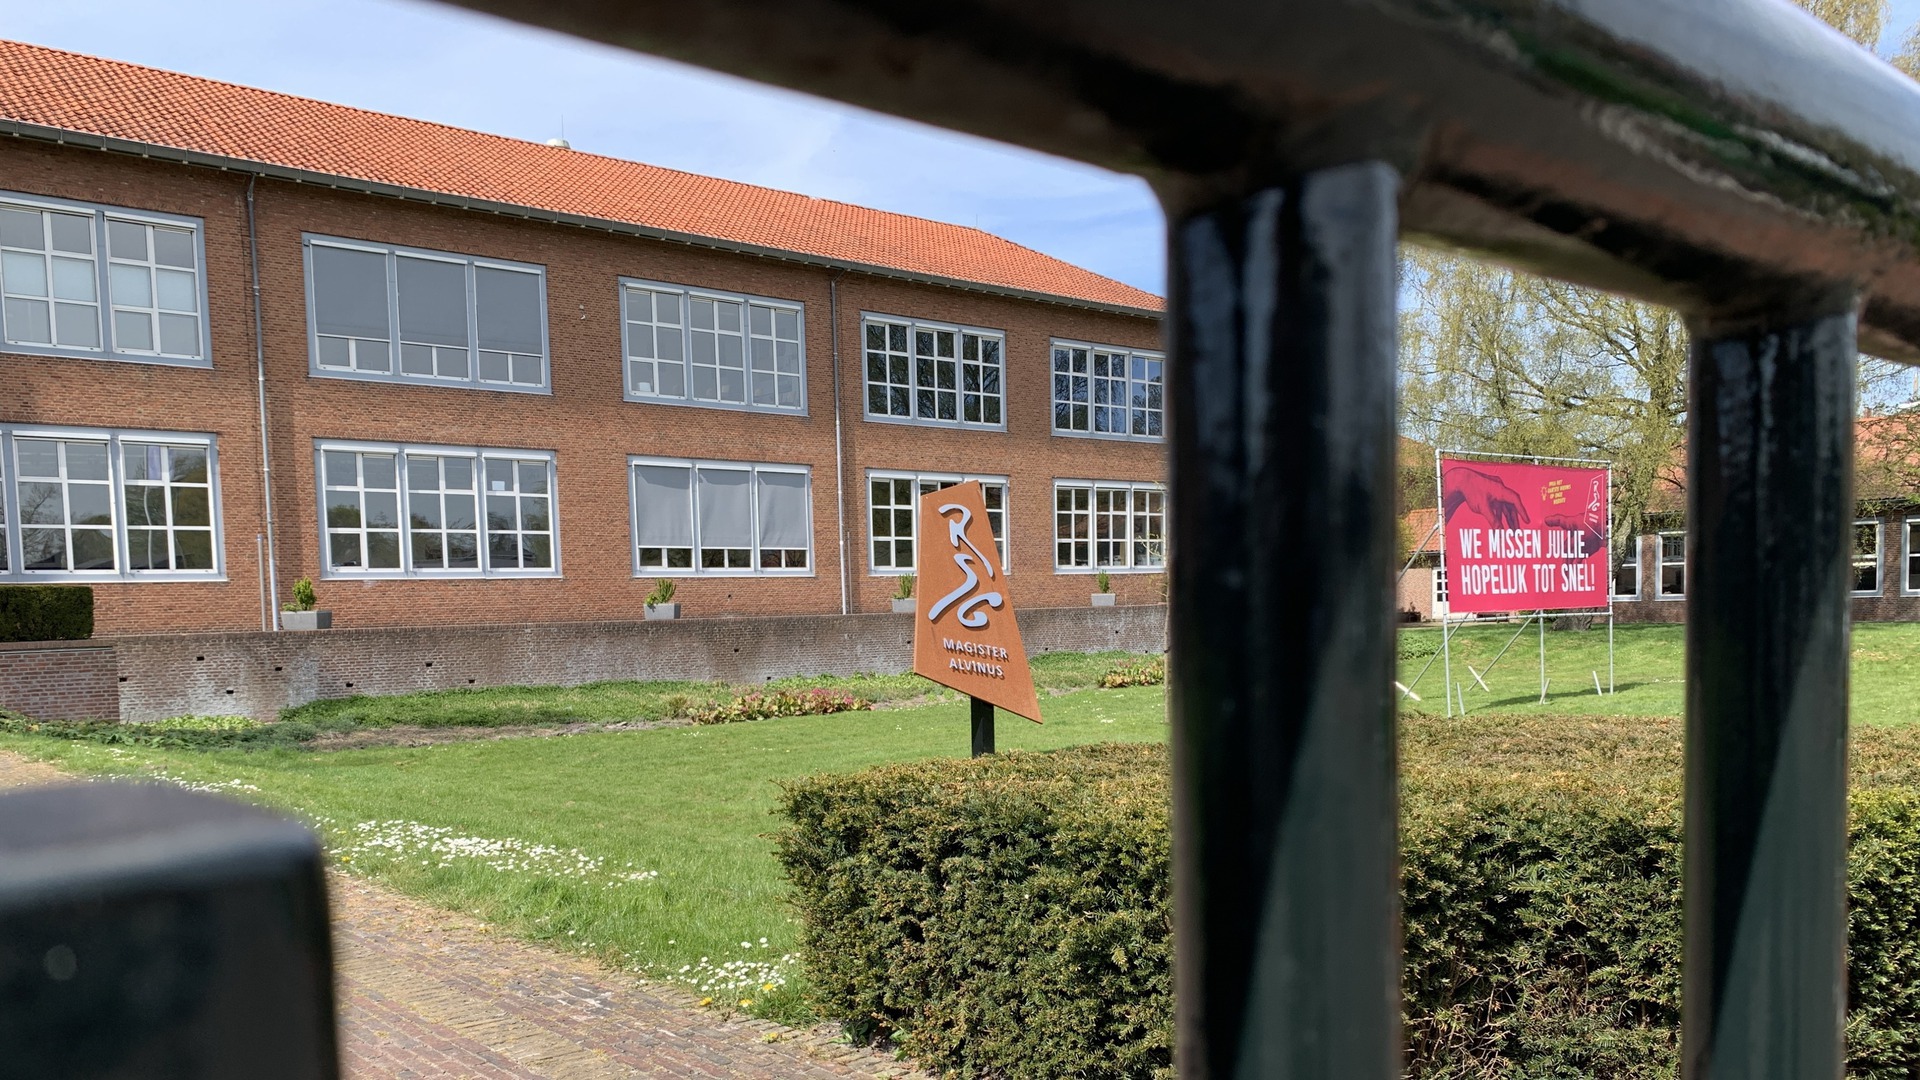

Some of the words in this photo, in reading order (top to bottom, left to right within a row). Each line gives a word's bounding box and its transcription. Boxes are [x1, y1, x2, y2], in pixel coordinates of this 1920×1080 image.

[1459, 528, 1482, 559] WE
[1488, 529, 1541, 559] MISSEN
[1546, 529, 1589, 559] JULLIE.
[1461, 564, 1528, 596] HOPELIJK
[1532, 563, 1556, 593] TOT
[1561, 563, 1595, 592] SNEL!
[943, 637, 1008, 660] MAGISTER
[949, 658, 1003, 677] ALVINUS
